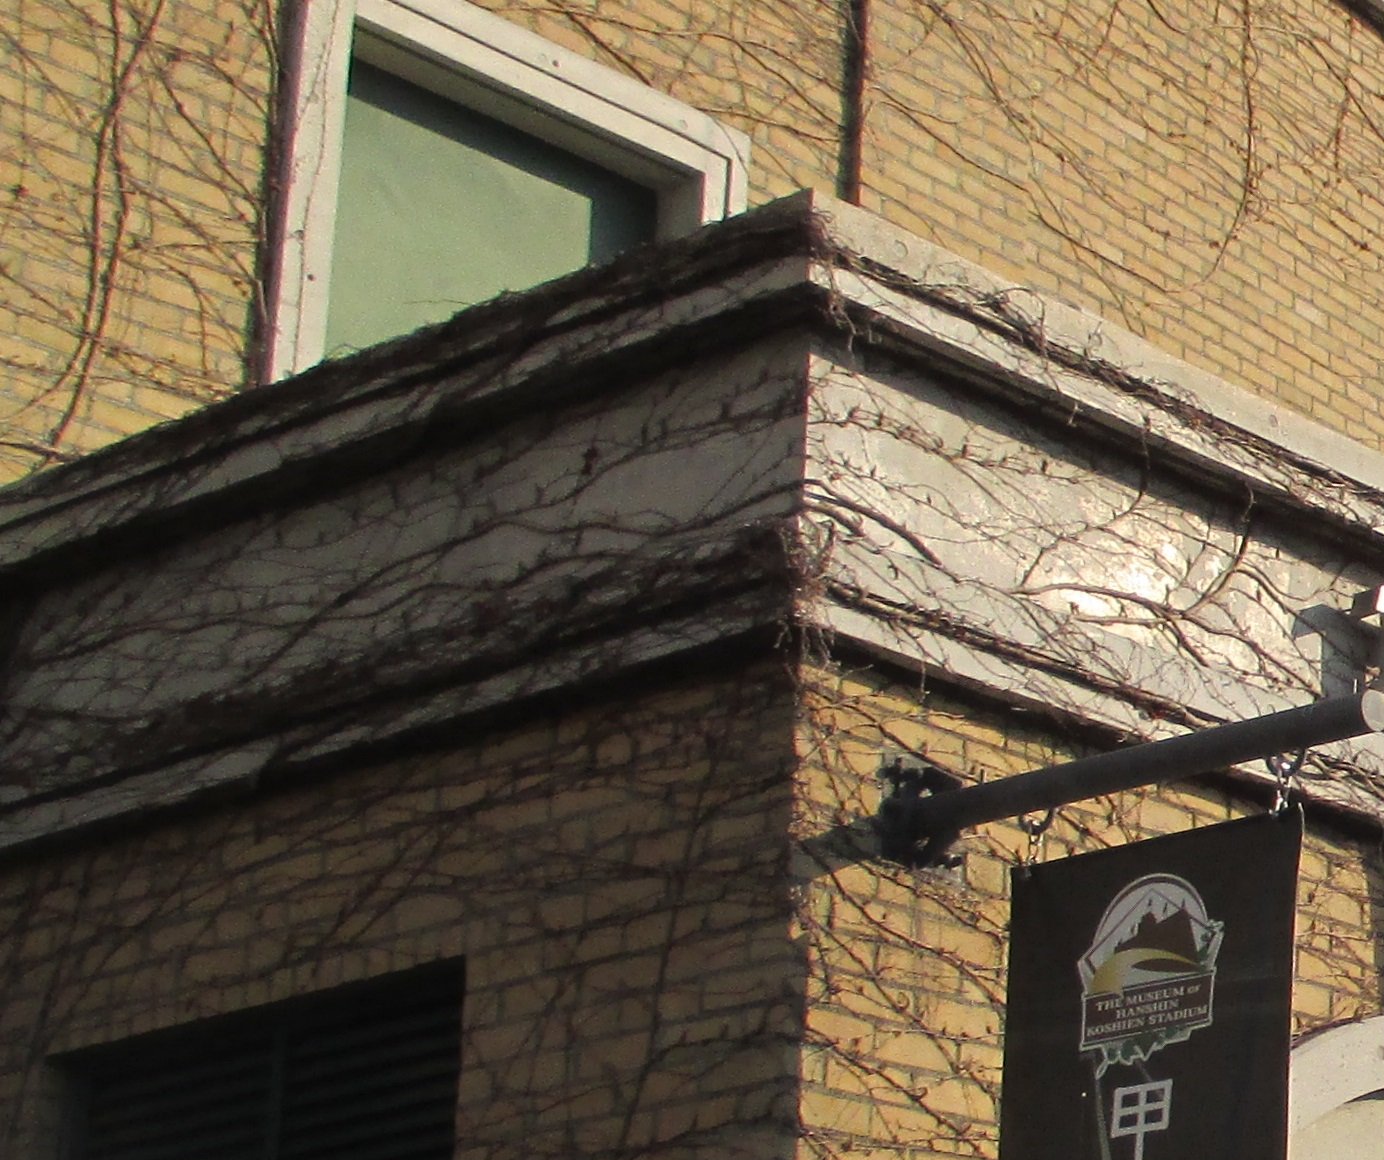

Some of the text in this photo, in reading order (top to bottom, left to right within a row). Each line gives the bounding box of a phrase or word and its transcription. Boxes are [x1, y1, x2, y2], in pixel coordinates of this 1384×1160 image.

[1095, 999, 1123, 1012] THE
[1126, 987, 1185, 1006] MUSEUM
[1116, 999, 1179, 1019] HANSHIN
[1087, 1005, 1208, 1037] KOSHIEN STADIUM
